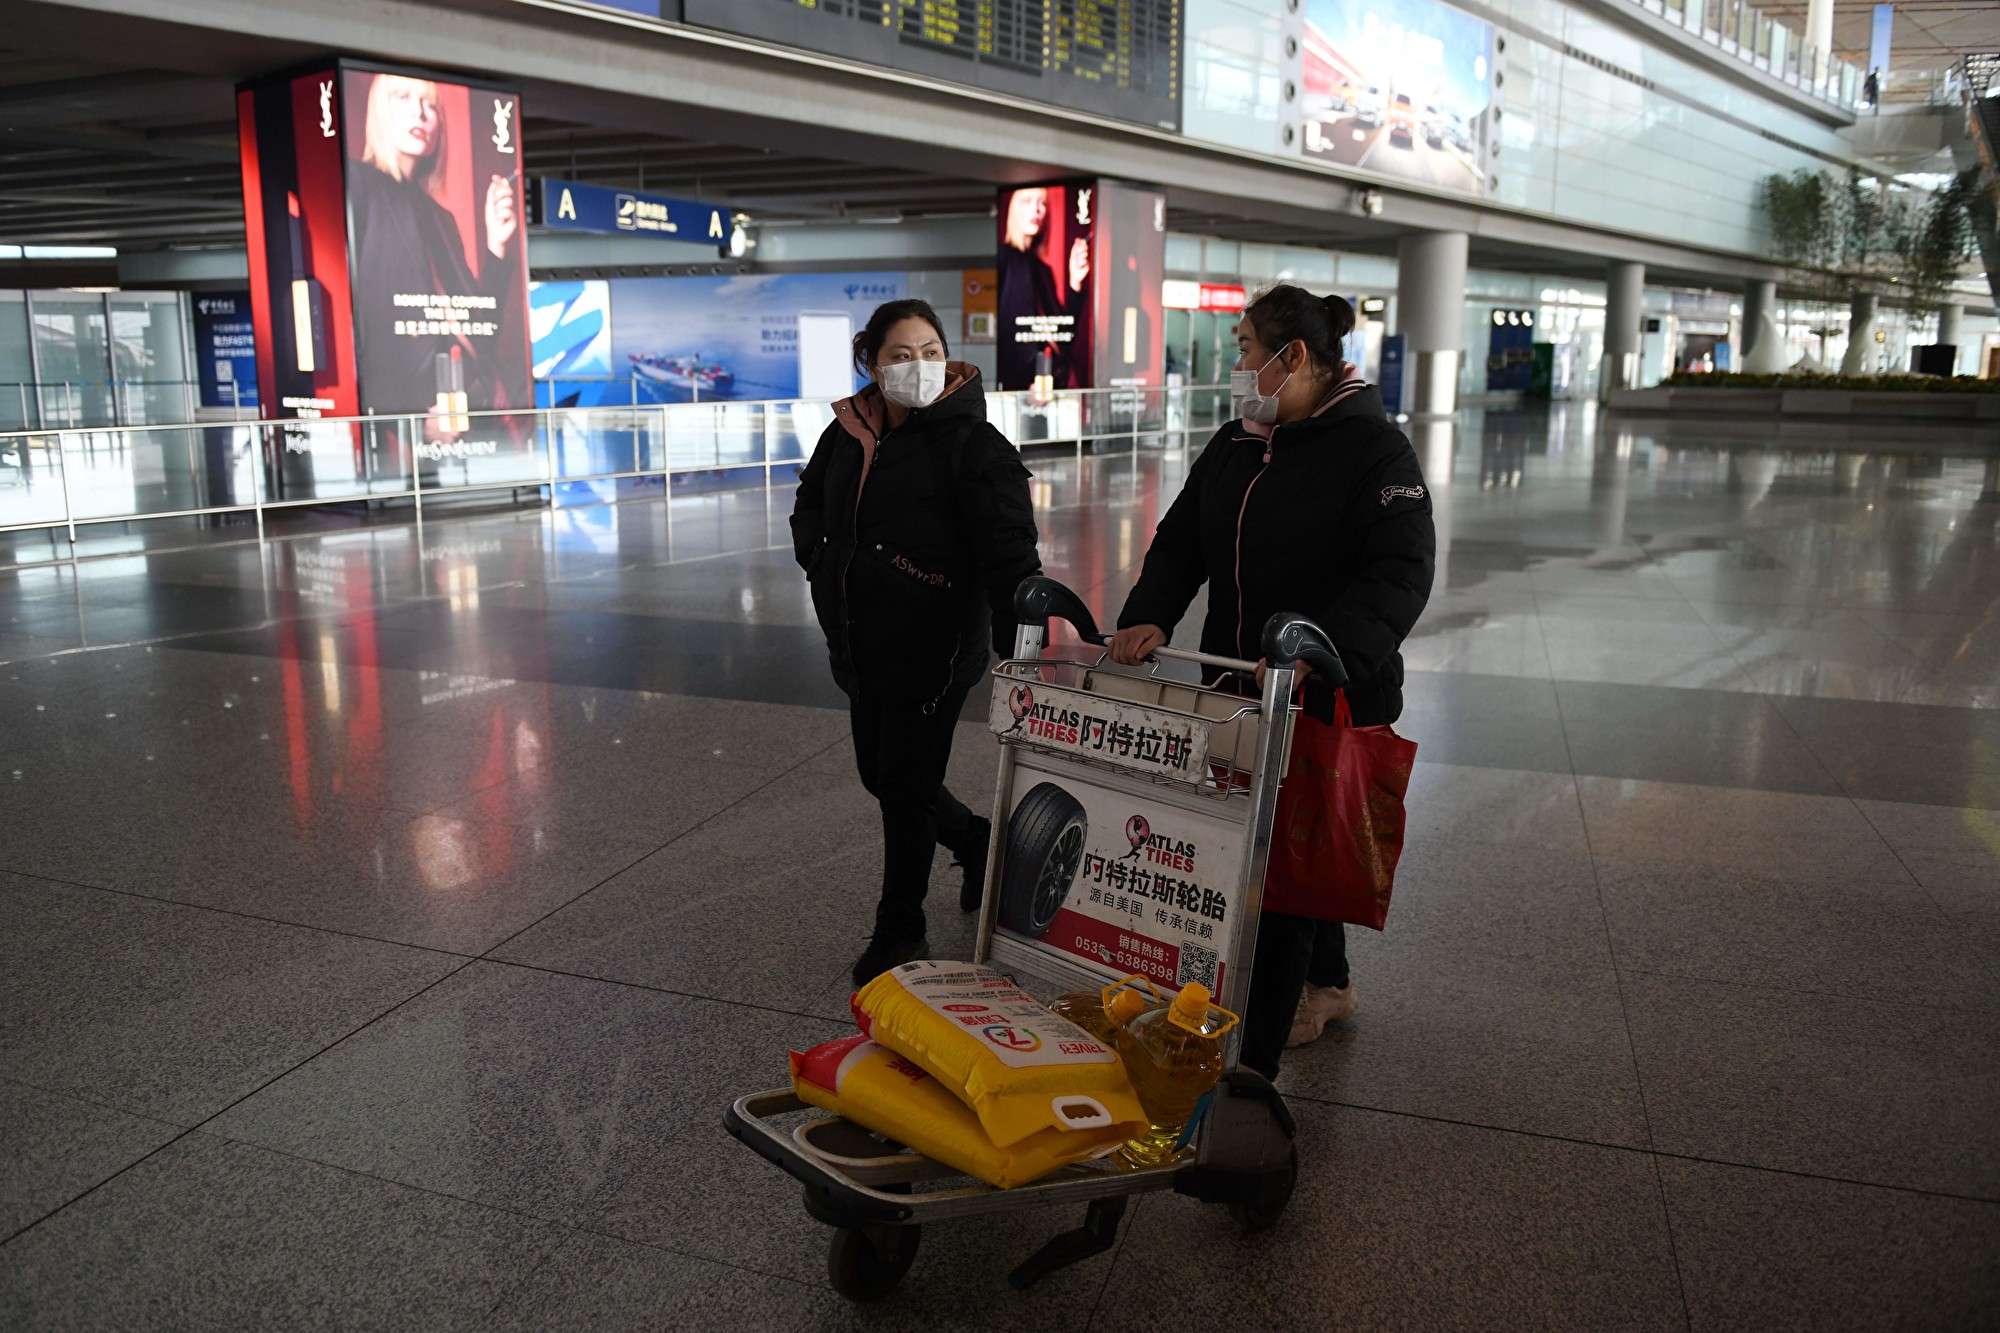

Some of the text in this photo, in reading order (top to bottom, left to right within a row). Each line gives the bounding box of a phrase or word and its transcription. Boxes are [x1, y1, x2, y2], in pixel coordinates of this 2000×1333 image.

[558, 188, 577, 221] A
[709, 210, 724, 239] A
[1029, 702, 1080, 728] ATLAS
[1028, 719, 1078, 744] TIRES
[1079, 715, 1193, 770] 阿特拉斯
[1145, 847, 1195, 873] TIRES
[1146, 833, 1196, 858] ATLAS
[1082, 853, 1227, 922] 阿特拉斯轮胎
[1089, 887, 1213, 941] 源自美国 传承信赖
